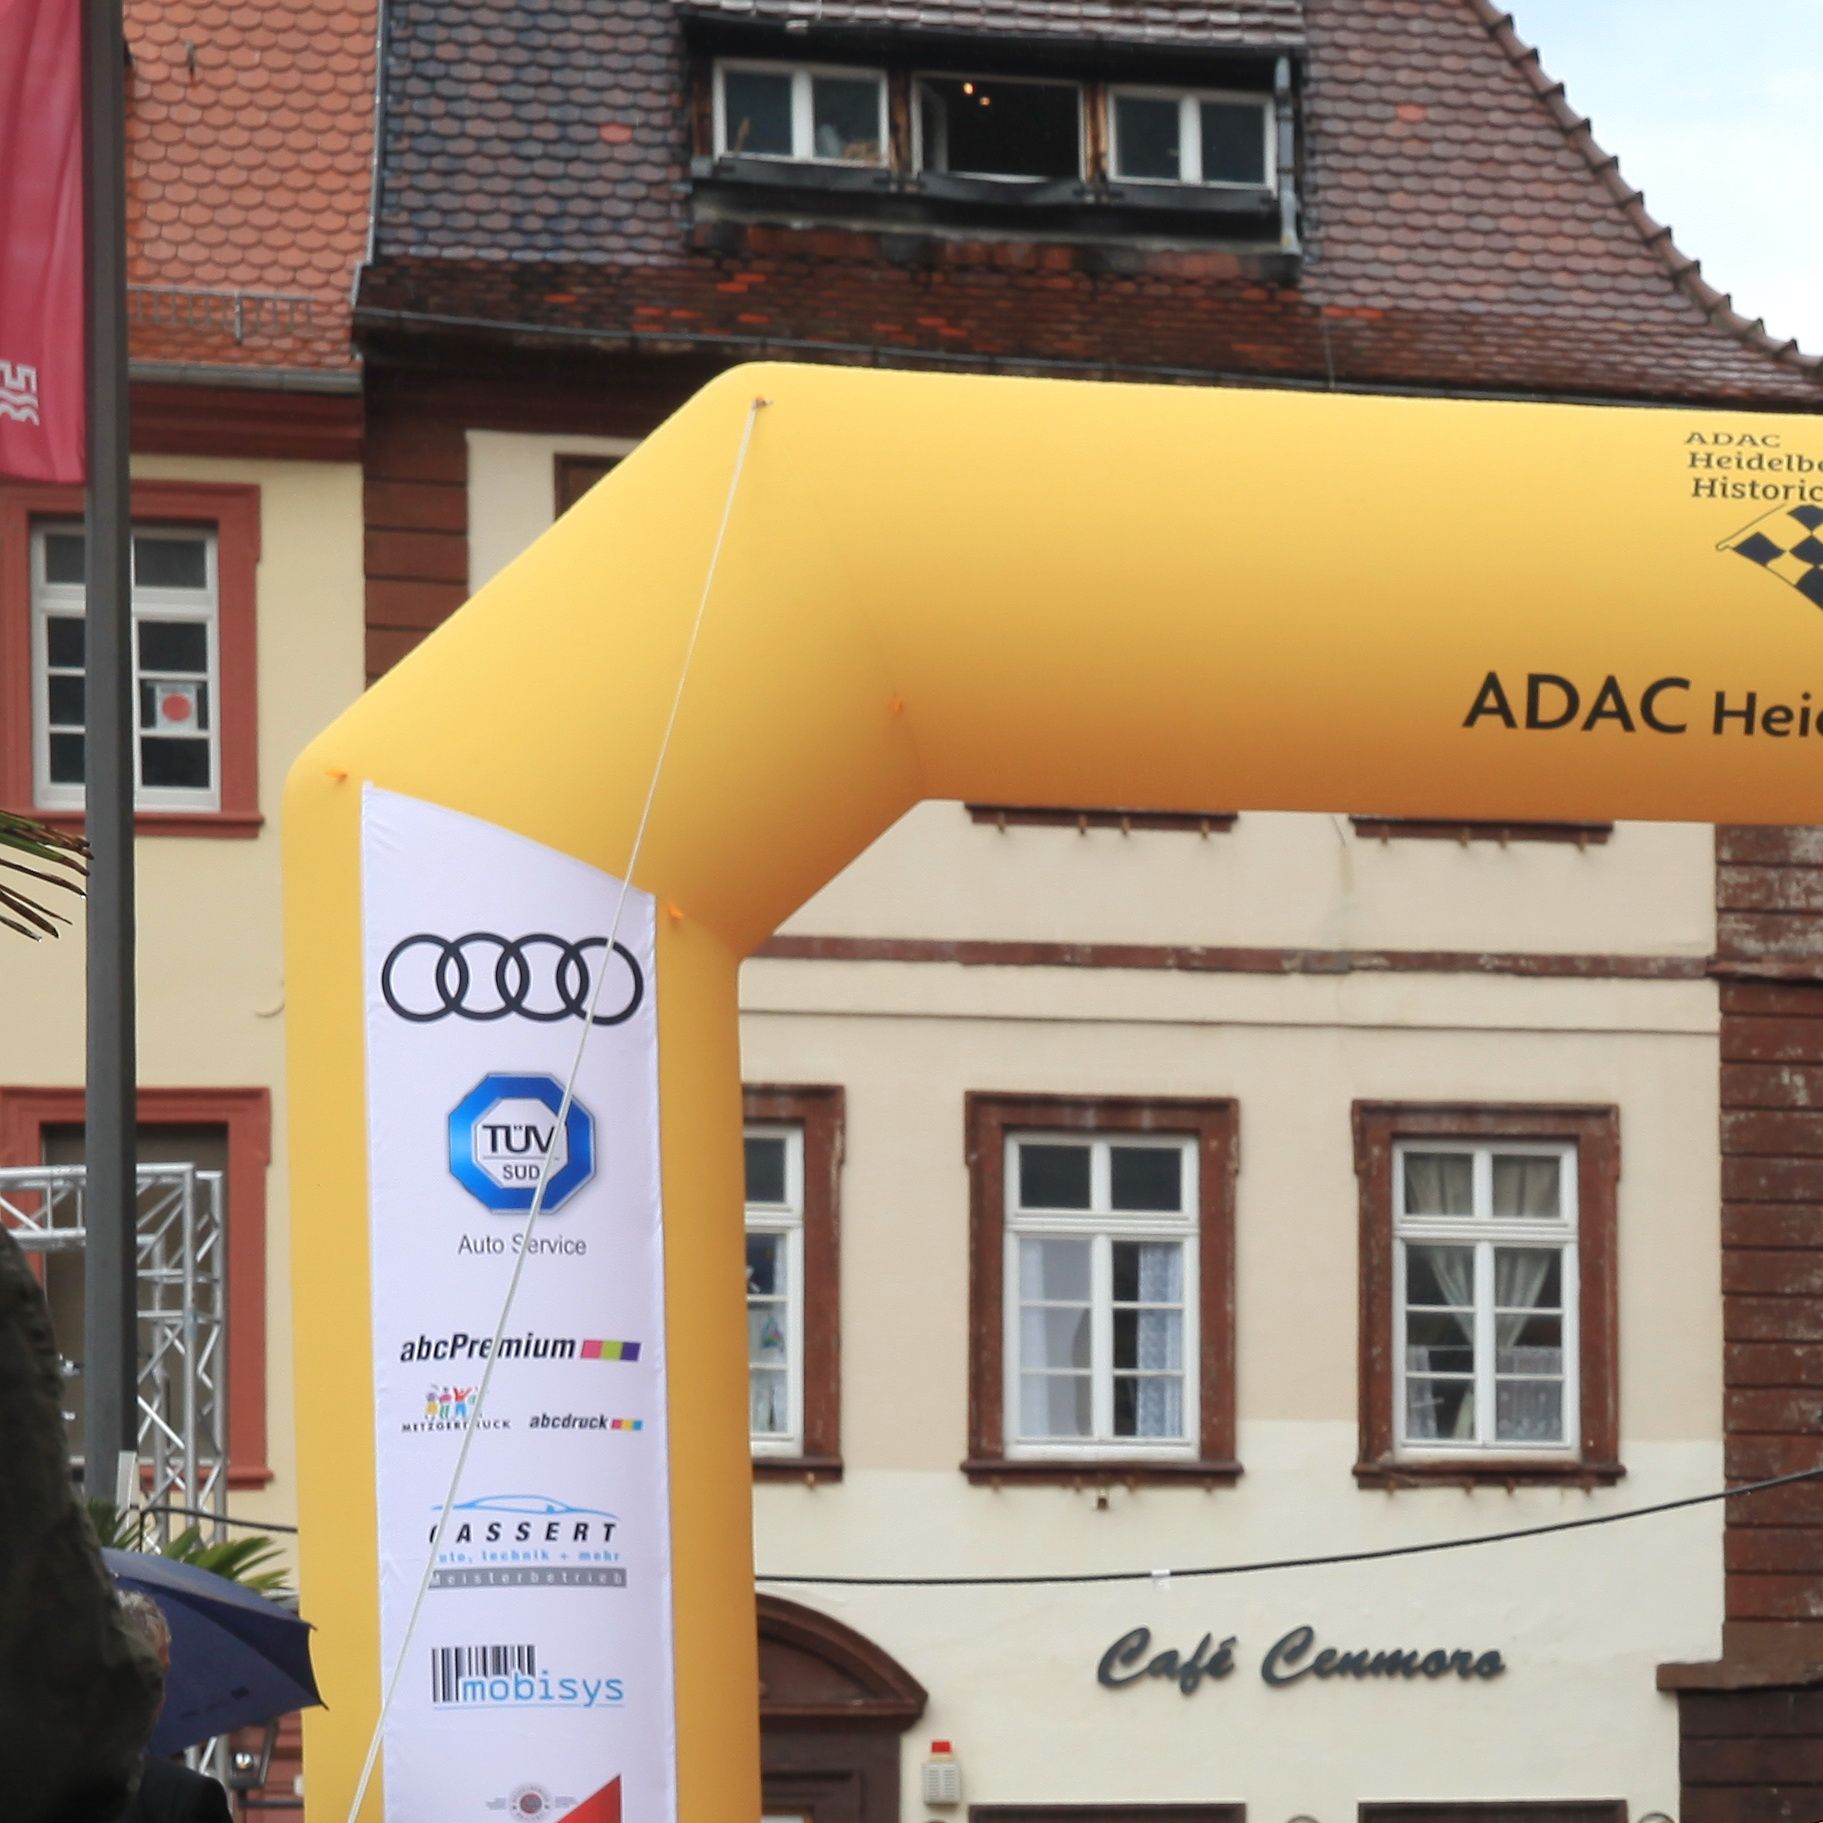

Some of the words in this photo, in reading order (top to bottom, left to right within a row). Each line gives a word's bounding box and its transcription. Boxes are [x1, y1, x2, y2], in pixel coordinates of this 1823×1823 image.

[1684, 431, 1782, 448] ADAC
[1461, 670, 1693, 738] ADAC
[481, 1124, 556, 1154] TÜV
[502, 1164, 541, 1182] SÜD
[457, 1234, 505, 1256] Auto
[511, 1233, 588, 1256] Service
[399, 1332, 577, 1363] abcPremium
[529, 1412, 609, 1432] abcdruck
[1098, 1626, 1238, 1695] Café
[461, 1670, 624, 1708] mobisys
